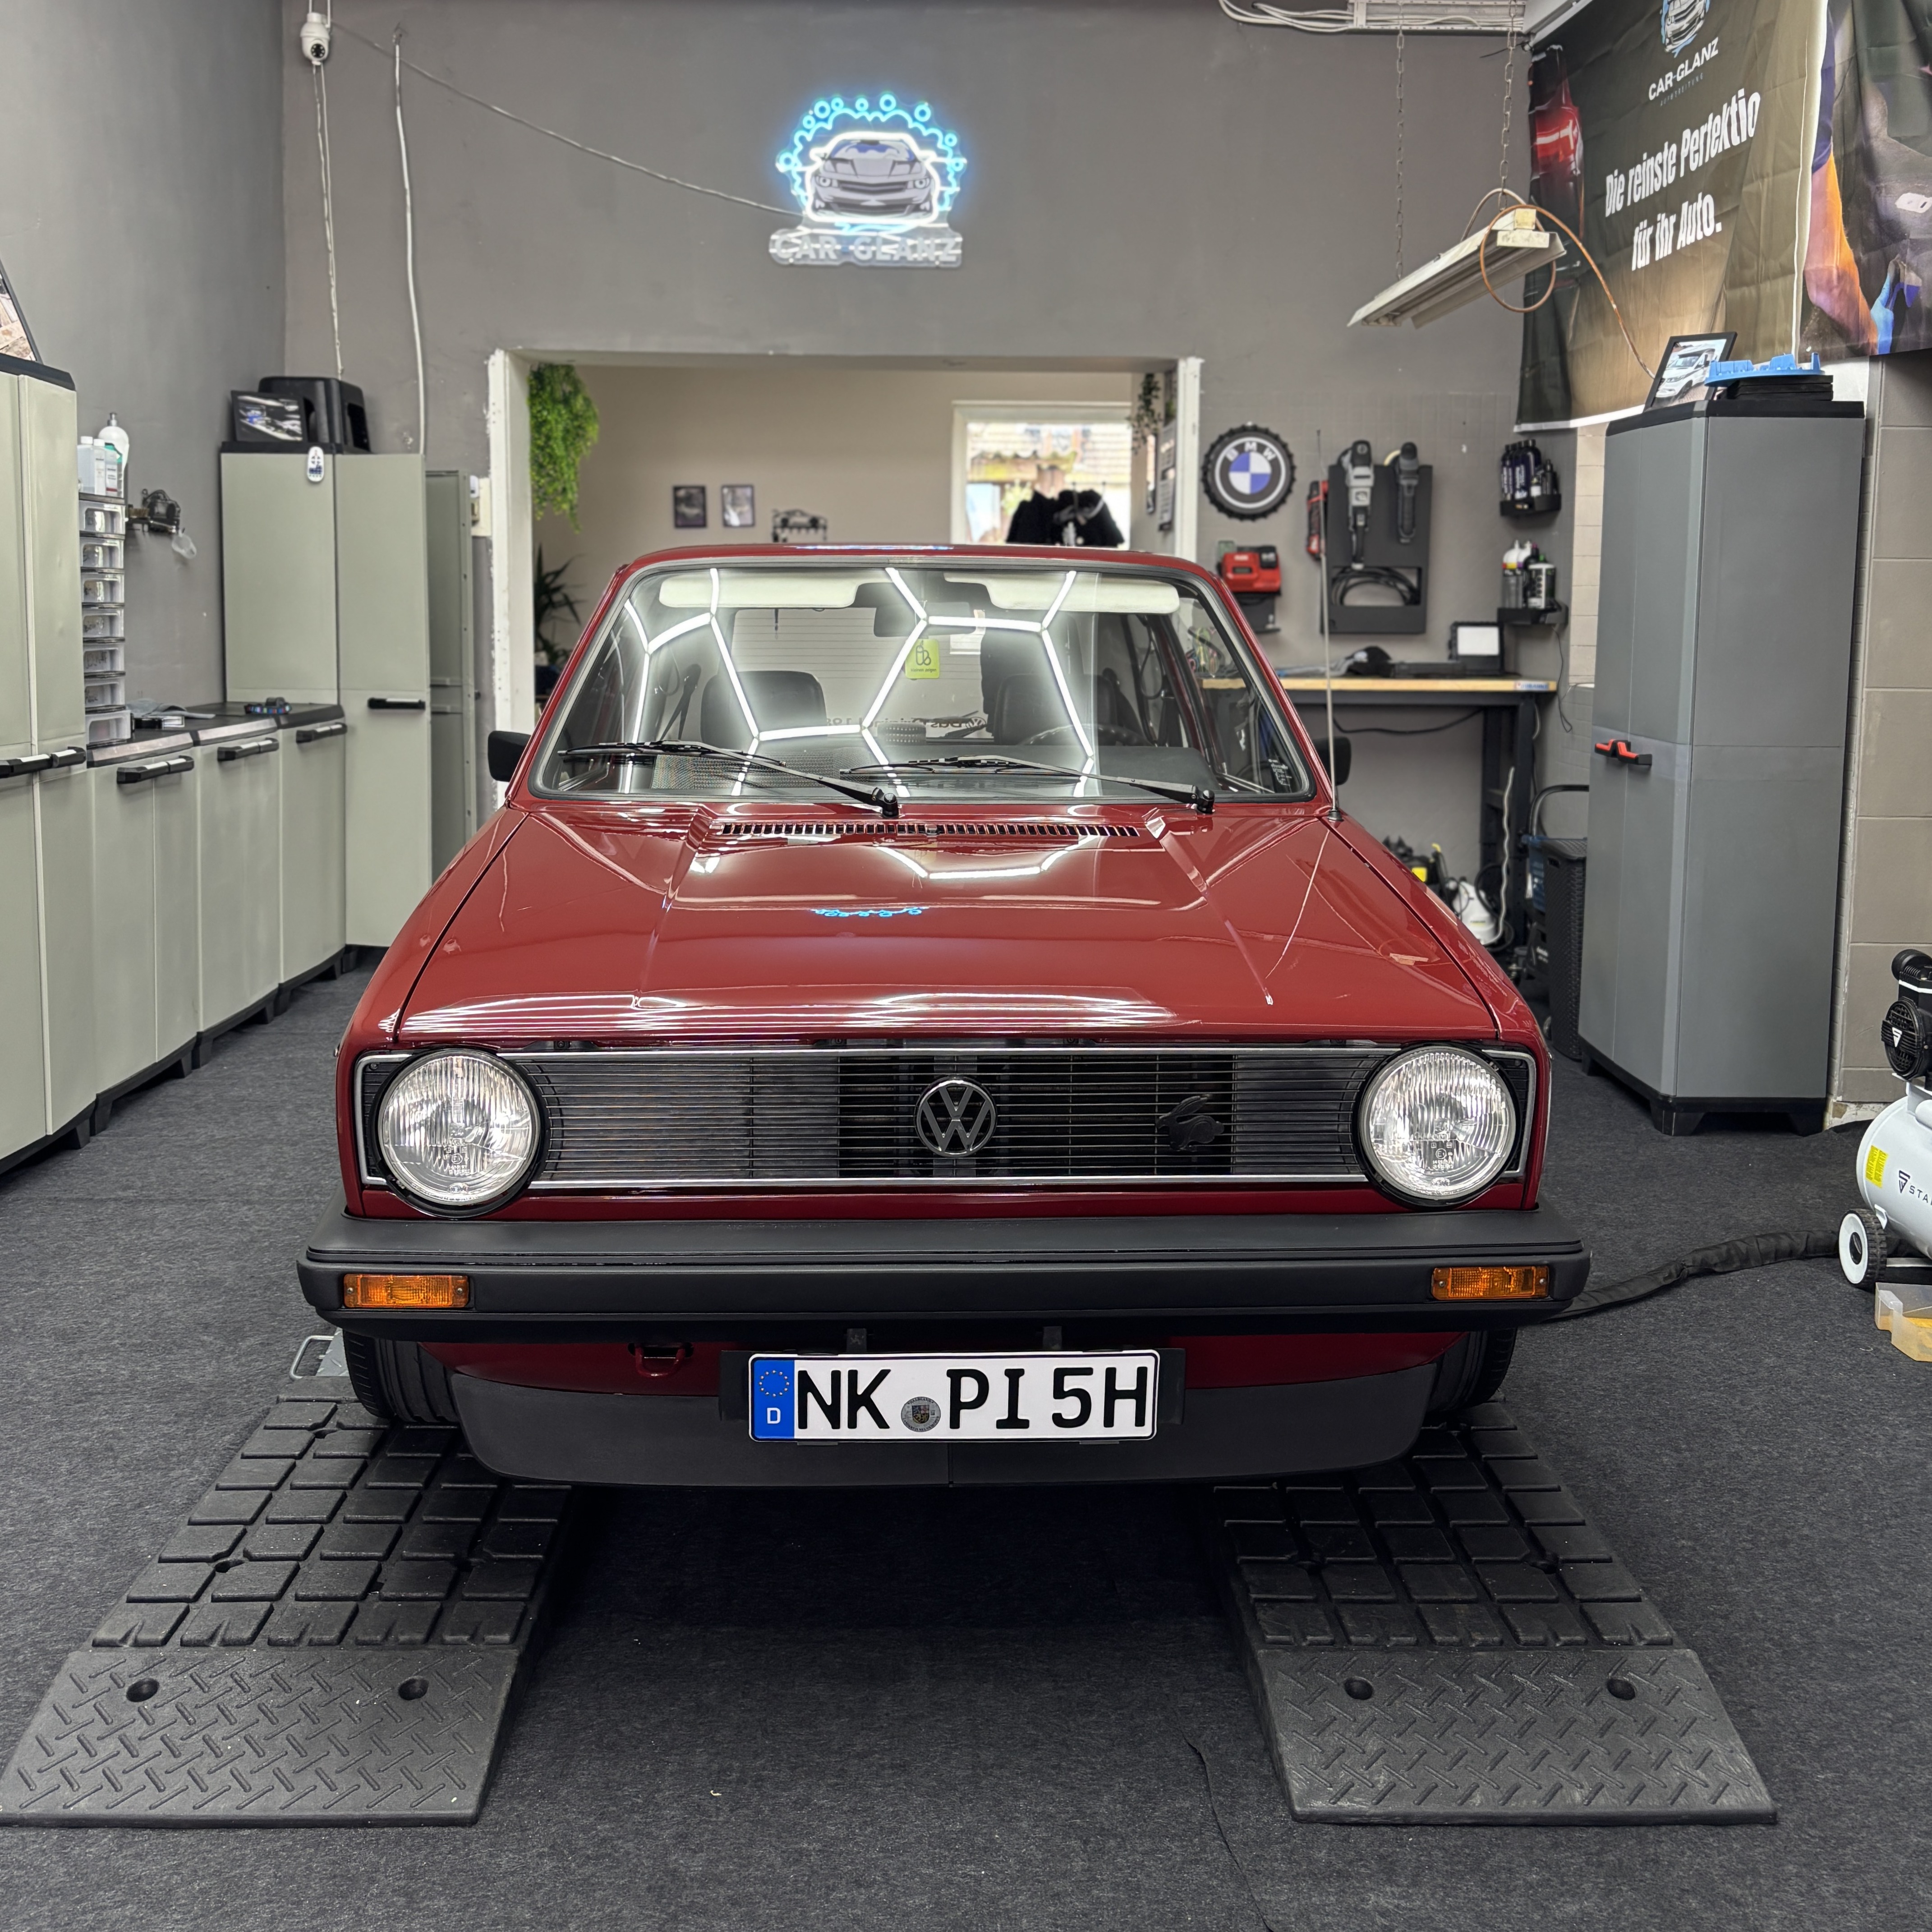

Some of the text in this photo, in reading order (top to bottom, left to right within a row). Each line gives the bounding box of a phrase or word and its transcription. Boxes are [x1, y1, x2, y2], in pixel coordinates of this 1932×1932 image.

[1648, 37, 1719, 101] CAR-GLANZ
[1605, 169, 1625, 217] Die
[1627, 141, 1677, 206] reinste
[1632, 192, 1722, 271] für ihr Auto.
[1909, 1185, 1932, 1205] STA
[767, 1407, 781, 1424] D
[797, 1366, 1148, 1430] NK PI 5H
